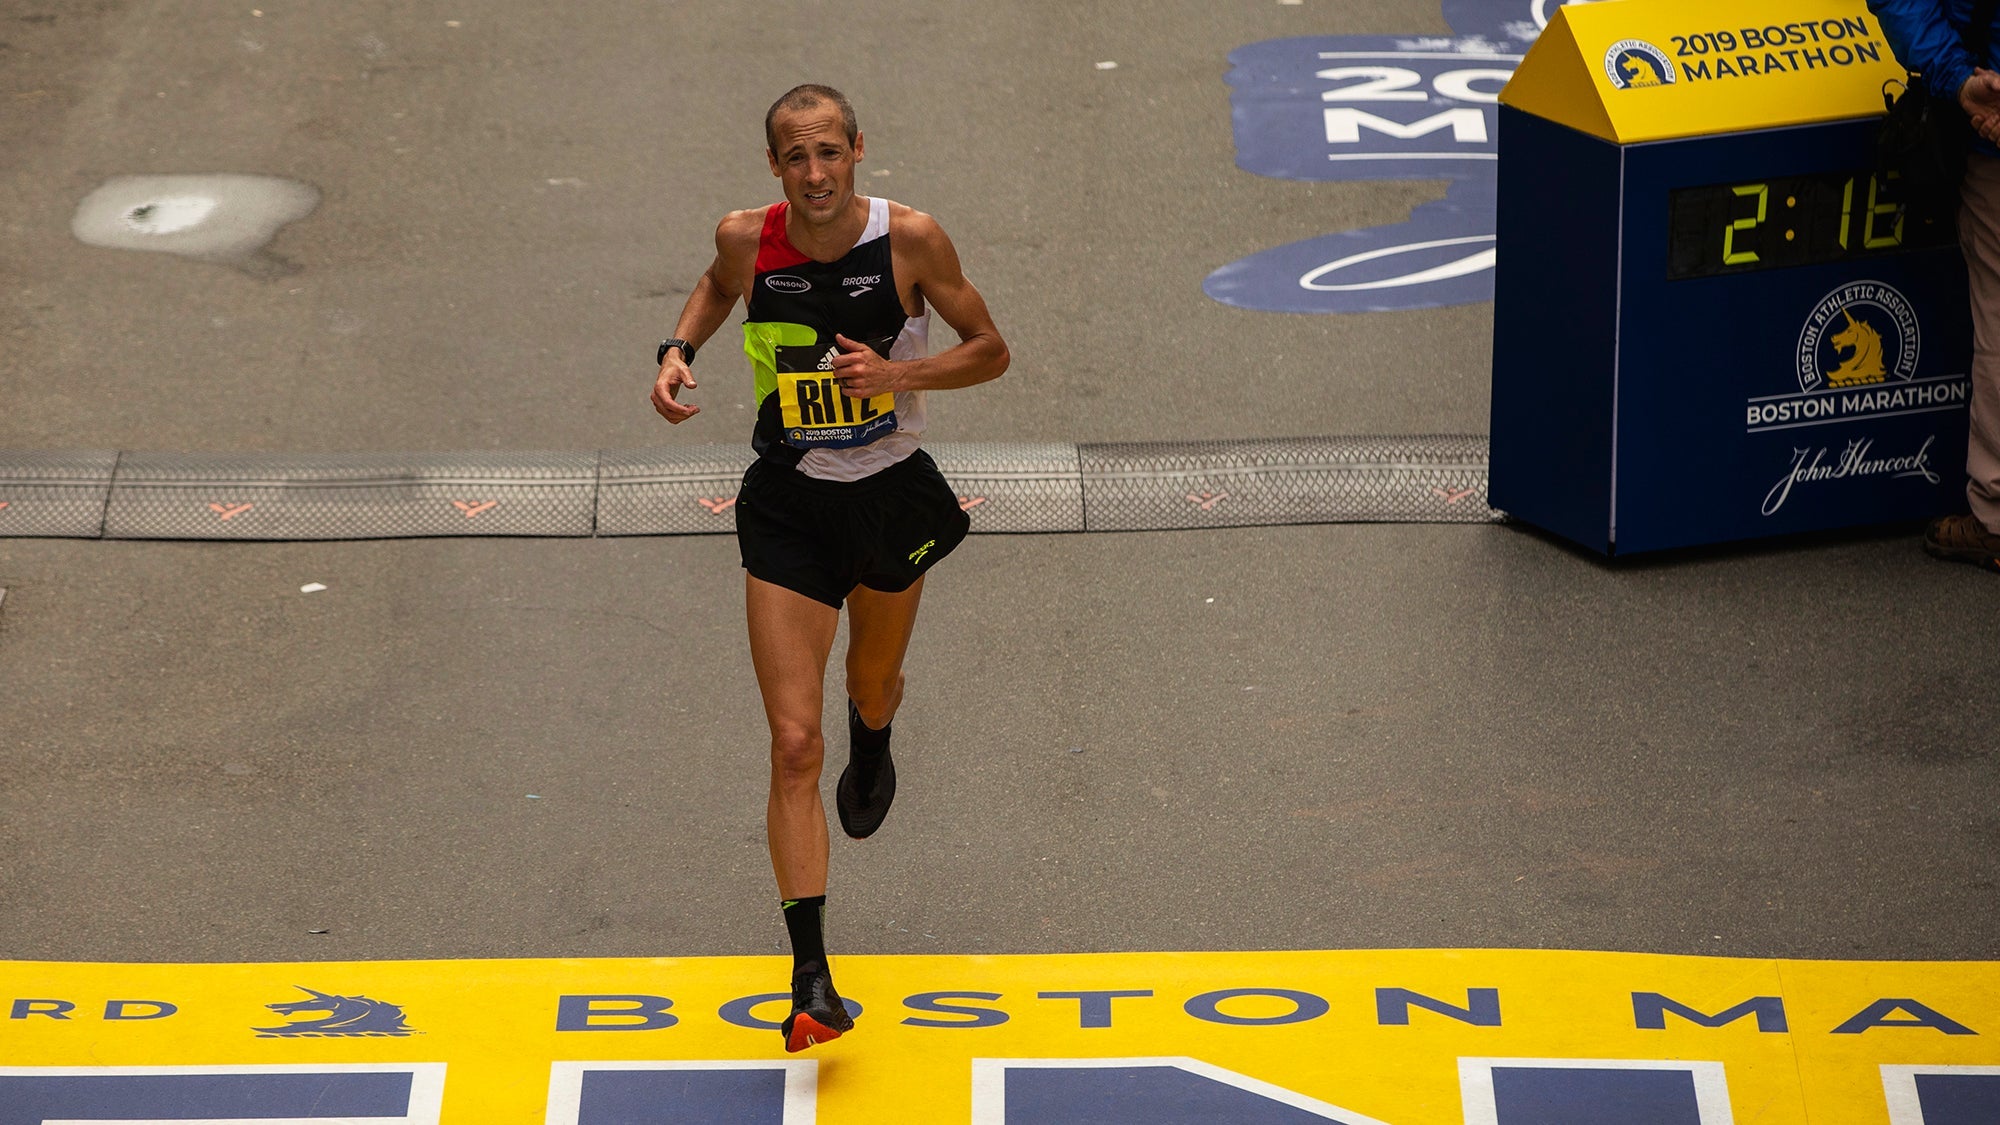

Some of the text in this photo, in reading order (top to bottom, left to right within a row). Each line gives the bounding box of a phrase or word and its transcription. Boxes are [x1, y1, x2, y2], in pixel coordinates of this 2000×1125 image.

[1670, 16, 1870, 57] 2019 BOSTON
[769, 280, 807, 289] HANSONS
[842, 274, 882, 286] BROOKS
[1801, 285, 1916, 384] BOSTON ATHLETIC ASSOCIATION
[1747, 396, 1836, 425] BOSTON
[820, 428, 852, 436] BOSTON
[1761, 435, 1941, 516] John Hancock
[556, 988, 1500, 1032] BOSTON
